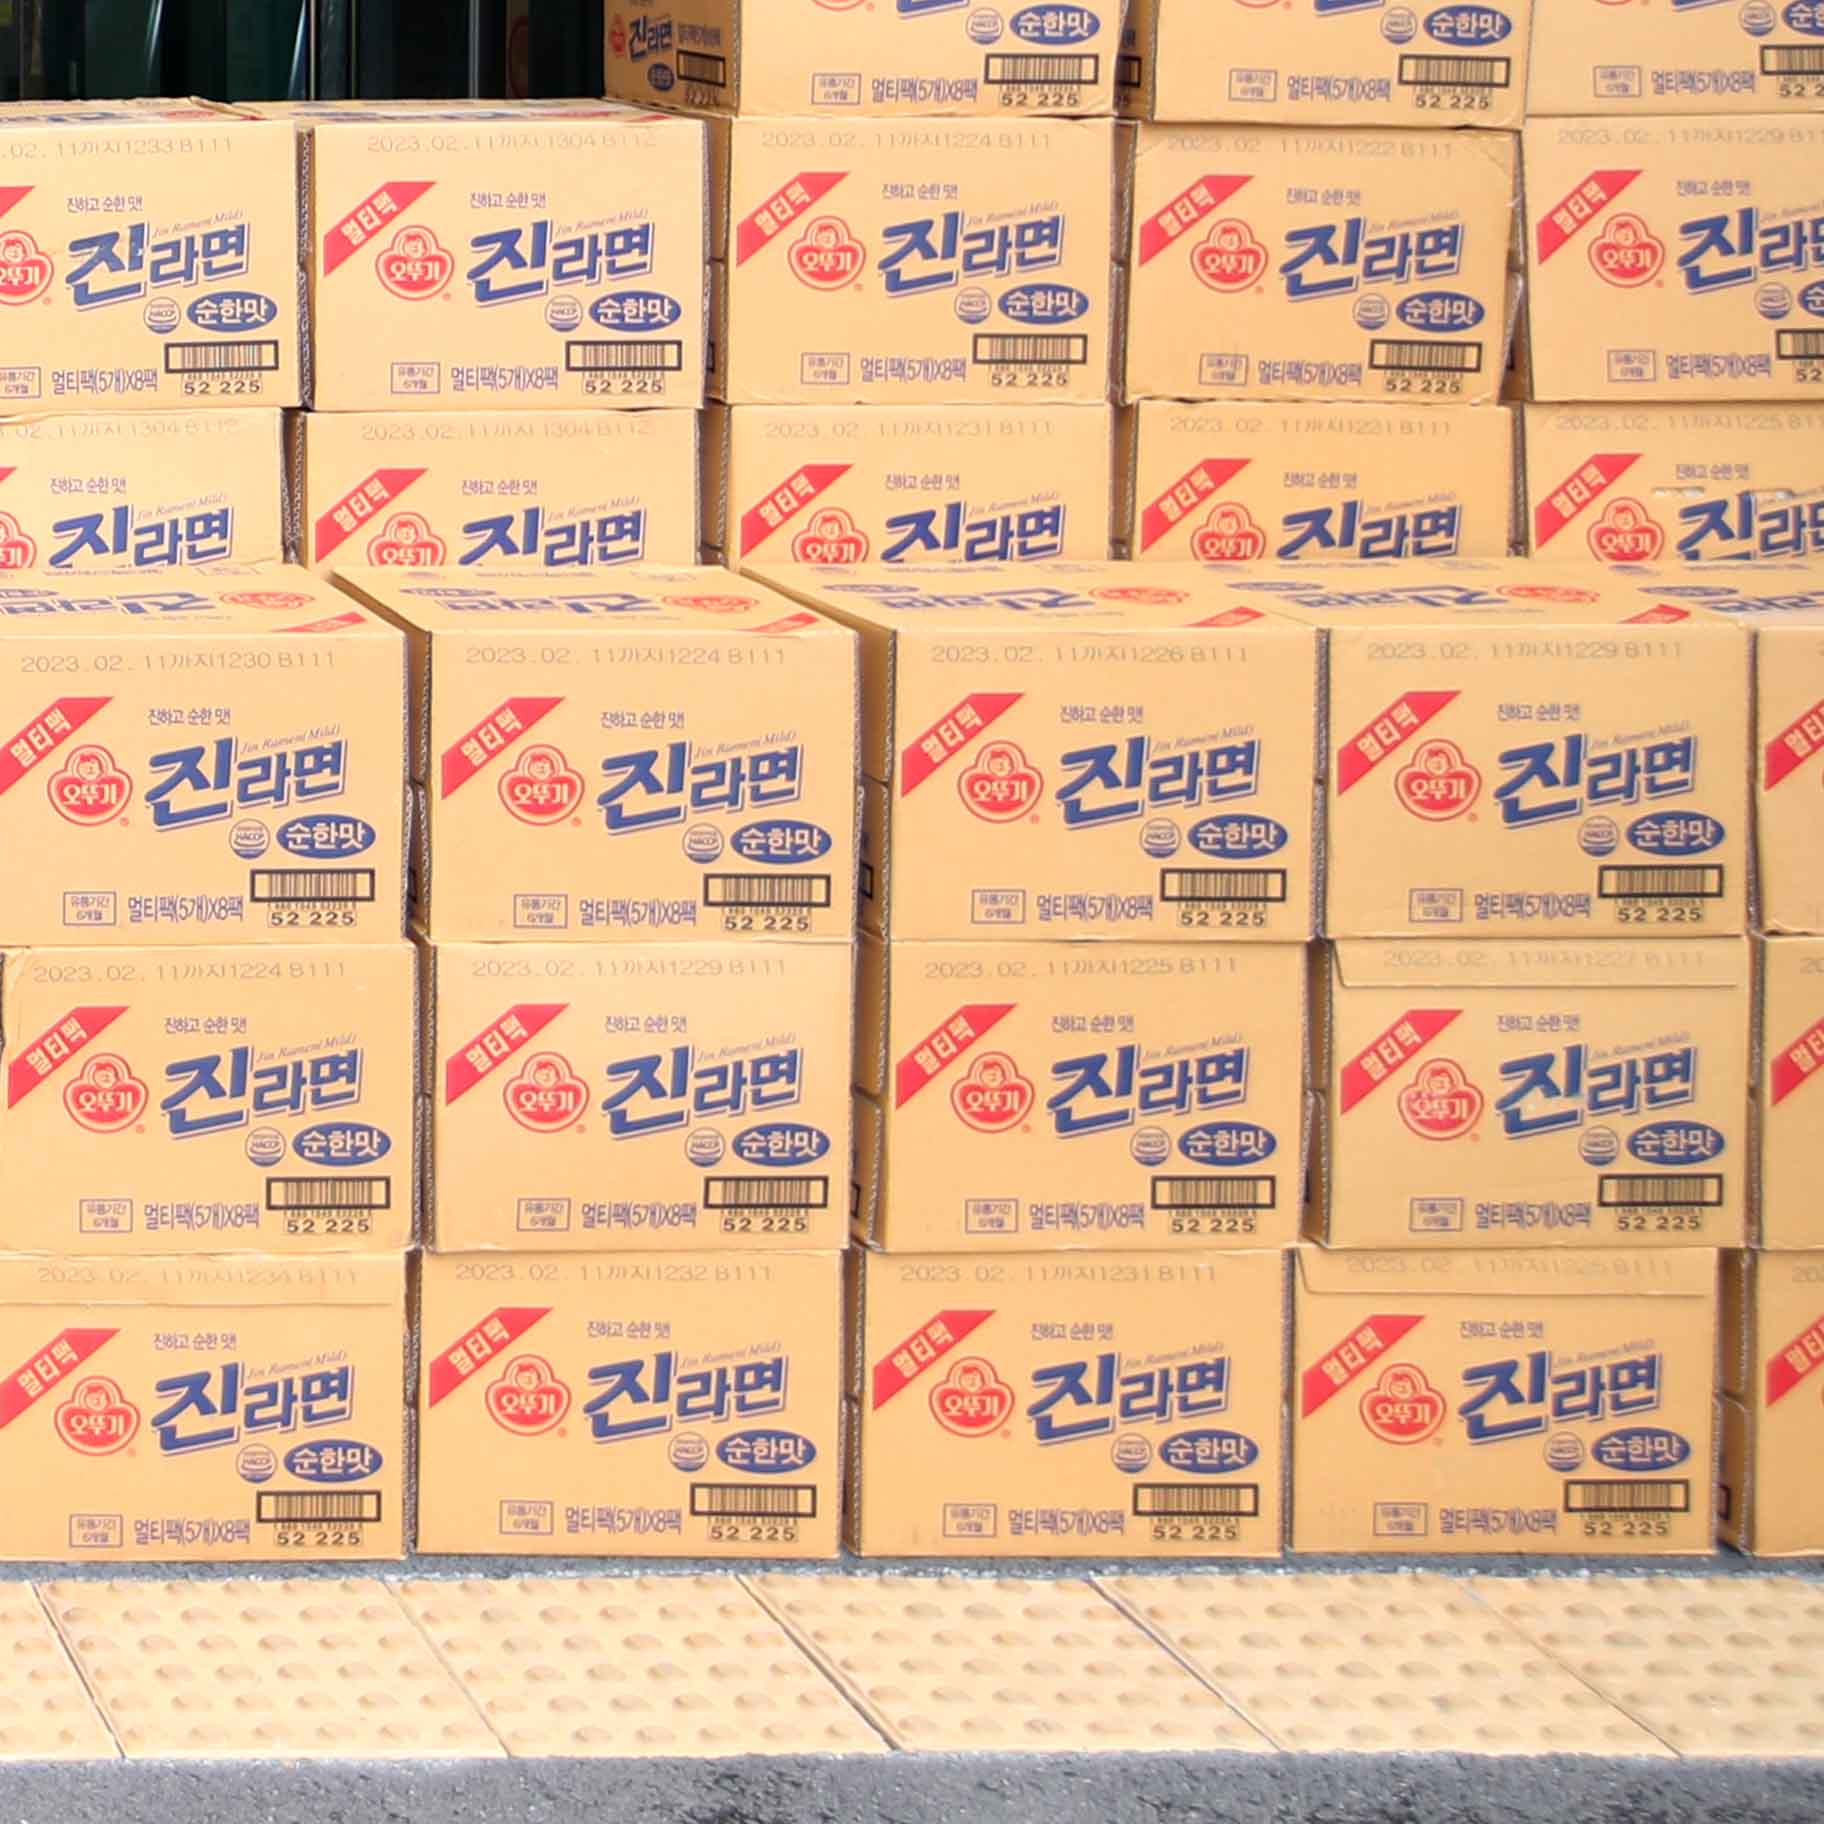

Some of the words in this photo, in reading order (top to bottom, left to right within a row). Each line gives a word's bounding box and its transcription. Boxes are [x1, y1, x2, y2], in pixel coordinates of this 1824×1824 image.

[1017, 10, 1091, 38] 순한맛
[1431, 12, 1504, 40] 순한맛
[466, 218, 655, 309] 진라면
[877, 209, 1064, 301] 진라면
[390, 262, 441, 283] 오뚜기
[597, 298, 673, 324] 순한맛
[1005, 290, 1080, 317] 순한맛
[9, 708, 72, 770] 멀티팩
[62, 784, 118, 806] 오뚜기
[144, 735, 348, 834] 진라면
[1410, 779, 1466, 802] 오뚜기
[1492, 731, 1698, 831] 진라면
[285, 822, 366, 851] 순한맛
[1634, 818, 1716, 848] 순한맛
[270, 913, 299, 926] 52
[310, 912, 354, 927] 225
[600, 1044, 804, 1142] 진라면
[740, 1130, 821, 1159] 순한맛
[1375, 1400, 1430, 1422] 오뚜기
[1457, 1351, 1663, 1447] 진라면
[1599, 1435, 1681, 1462] 순한맛
